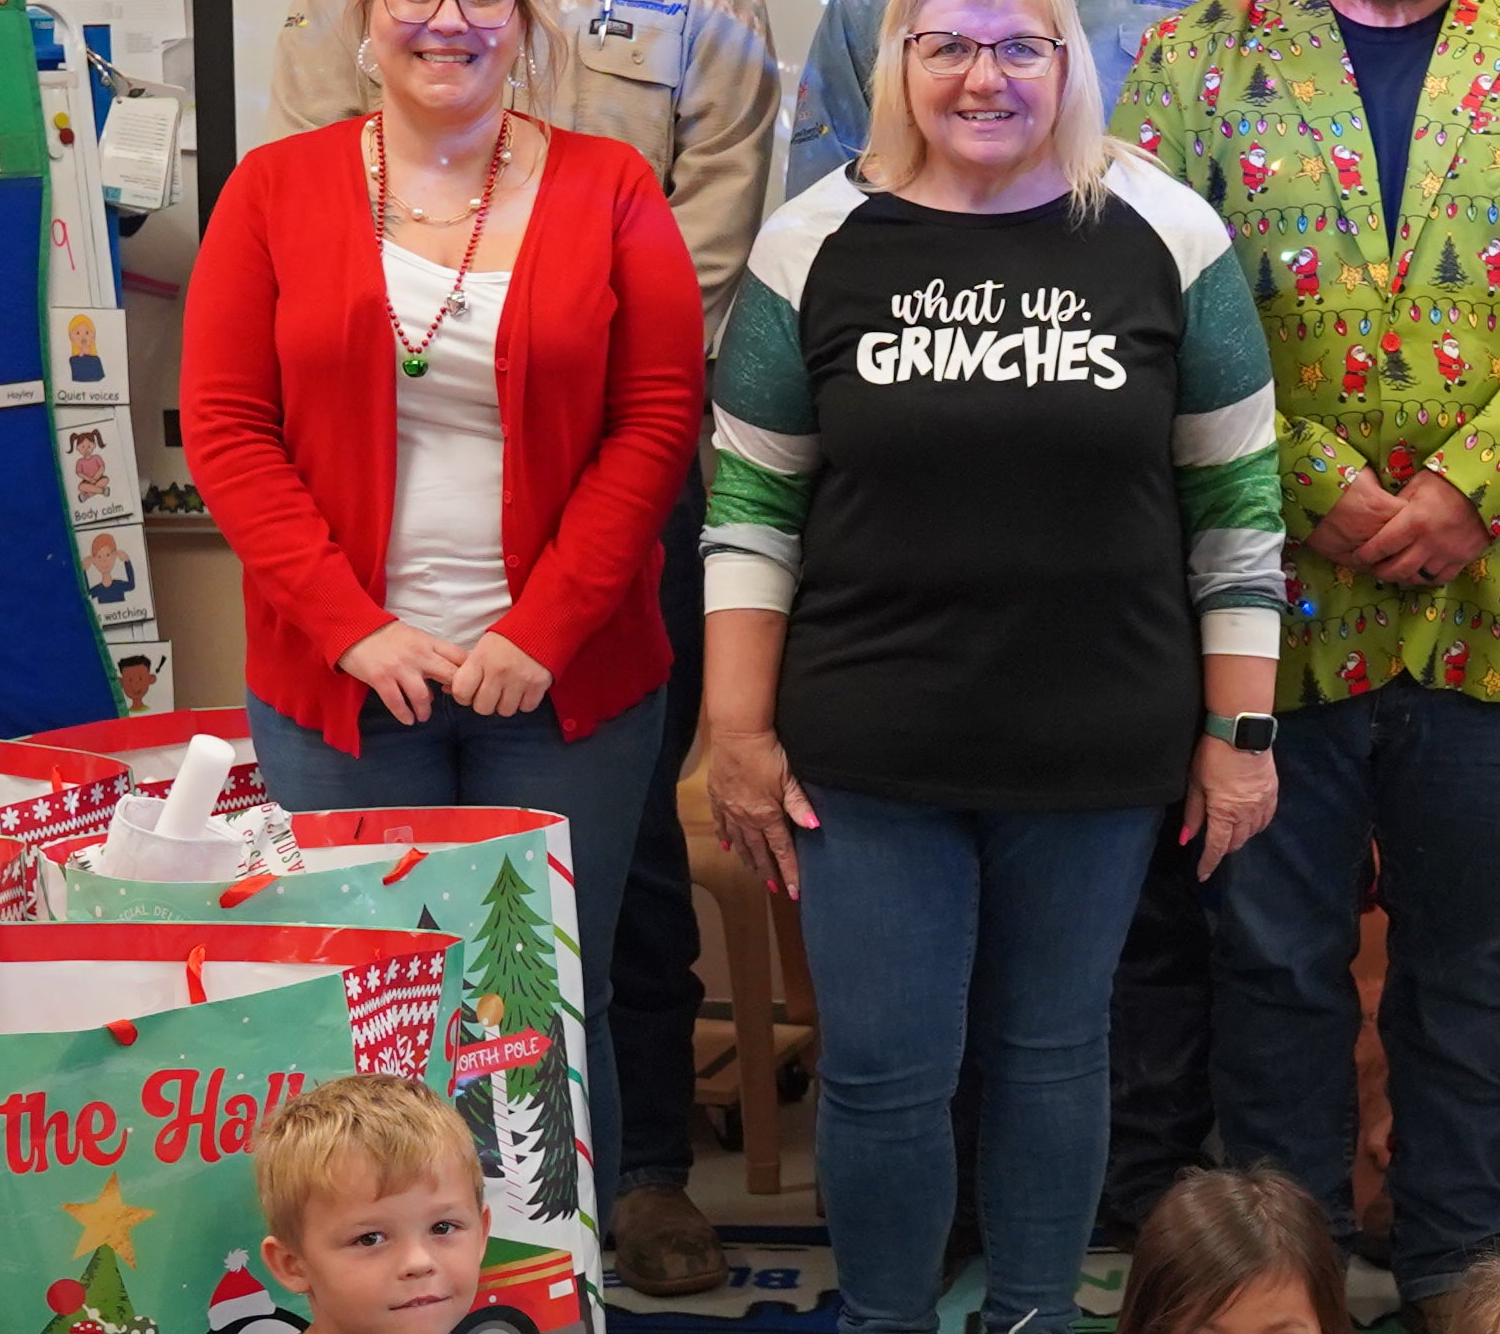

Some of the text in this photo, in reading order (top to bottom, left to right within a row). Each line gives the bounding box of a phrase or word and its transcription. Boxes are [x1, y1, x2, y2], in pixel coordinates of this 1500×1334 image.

[892, 278, 1006, 325] what
[856, 325, 1128, 391] GRINCHES
[6, 388, 35, 402] Hayley
[57, 390, 120, 403] Quiet voices
[74, 503, 125, 521] Body calm
[504, 1037, 541, 1061] POLE
